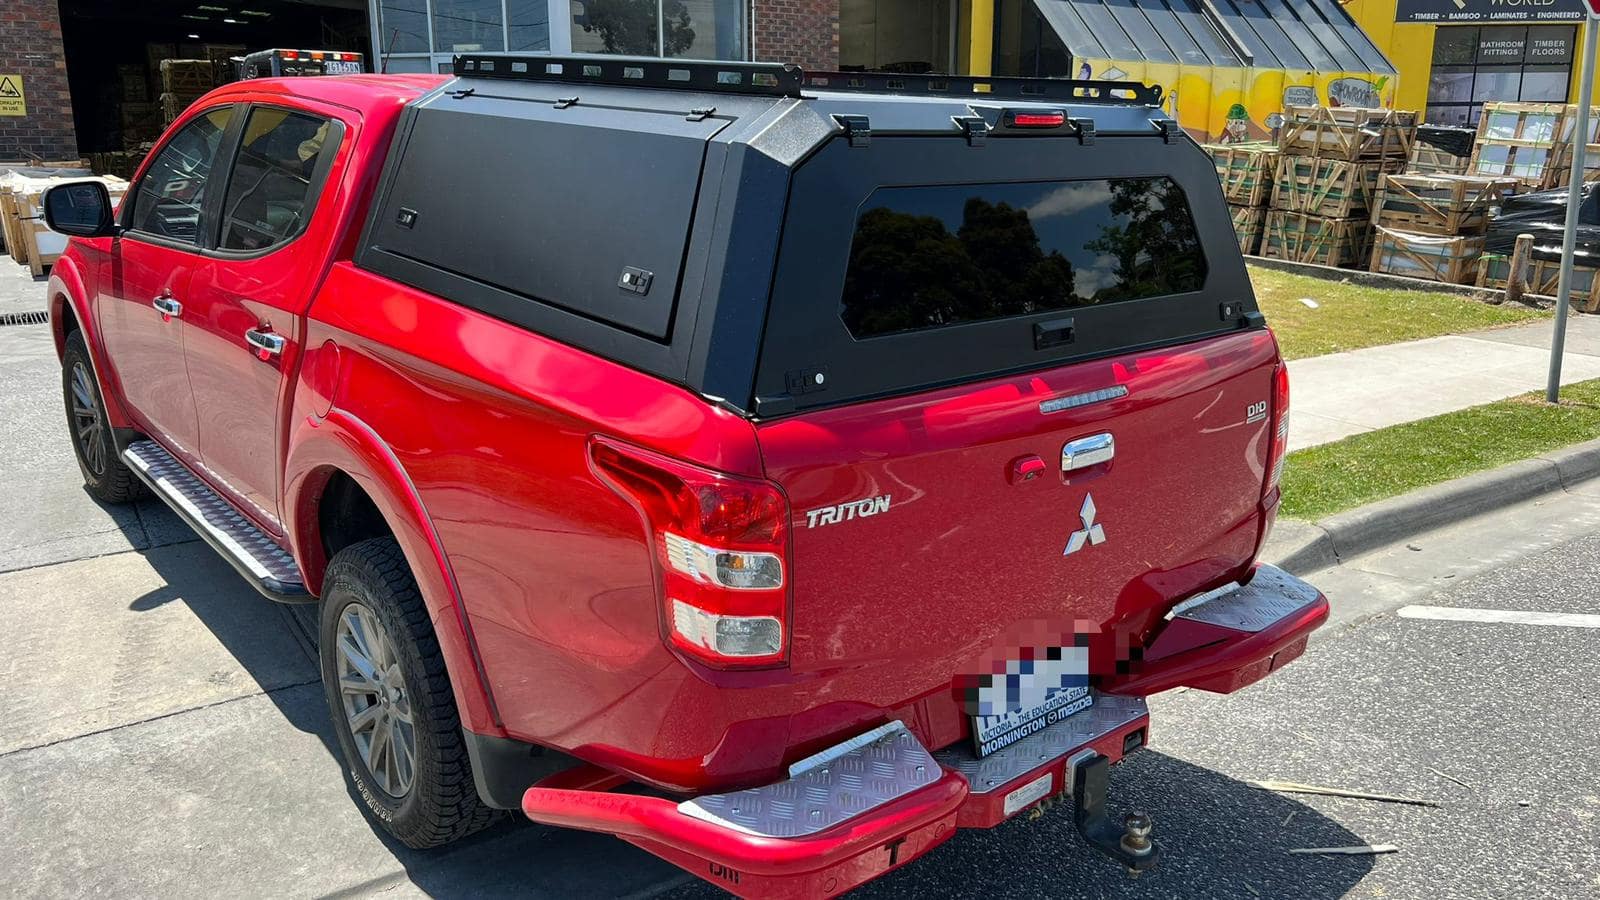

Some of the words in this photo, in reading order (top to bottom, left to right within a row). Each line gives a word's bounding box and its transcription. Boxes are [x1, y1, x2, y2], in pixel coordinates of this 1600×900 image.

[1414, 12, 1440, 20] TIMBER
[1449, 12, 1480, 20] BAMBOO
[1537, 11, 1581, 19] ENGINEERED
[1480, 41, 1524, 49] BATHROOM
[1532, 48, 1566, 56] FLOORS
[806, 494, 892, 529] TRITON
[981, 720, 1013, 742] VICTORIA
[1018, 713, 1031, 724] THE
[1032, 693, 1069, 718] EDUCATION
[1070, 686, 1088, 700] STATE
[981, 716, 1046, 757] MORNINGTON
